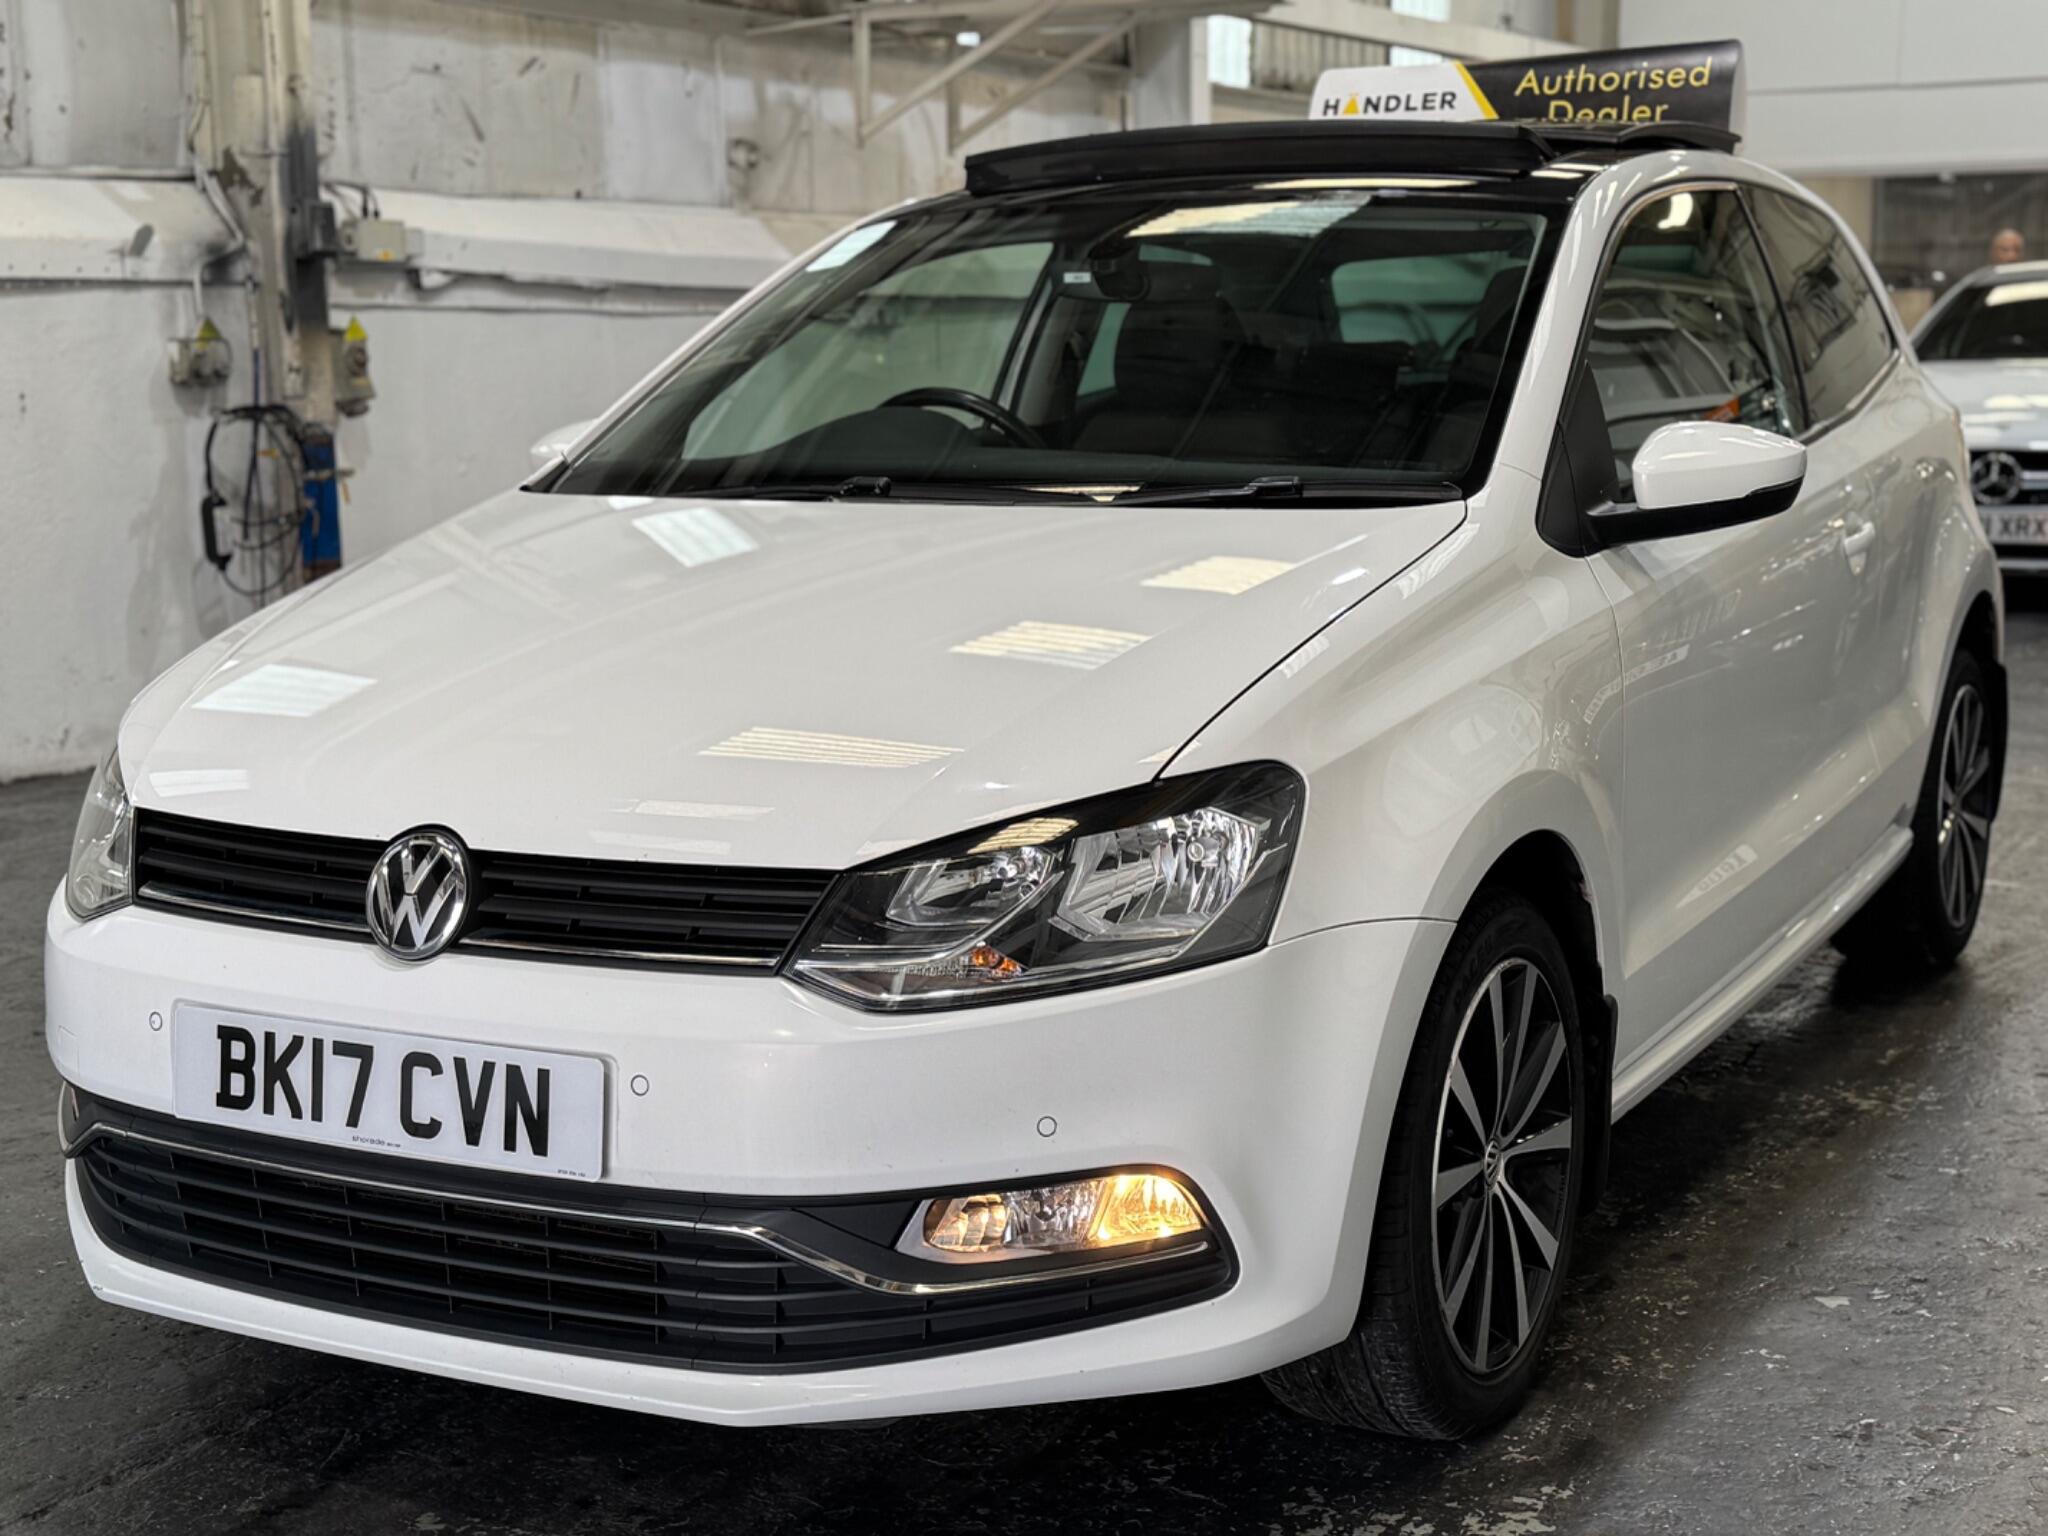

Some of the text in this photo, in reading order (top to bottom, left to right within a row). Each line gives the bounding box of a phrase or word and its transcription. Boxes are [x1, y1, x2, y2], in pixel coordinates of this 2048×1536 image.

[1514, 56, 1713, 96] Authorised
[1548, 95, 1670, 122] Dealer
[215, 1023, 551, 1158] BK17 CVN
